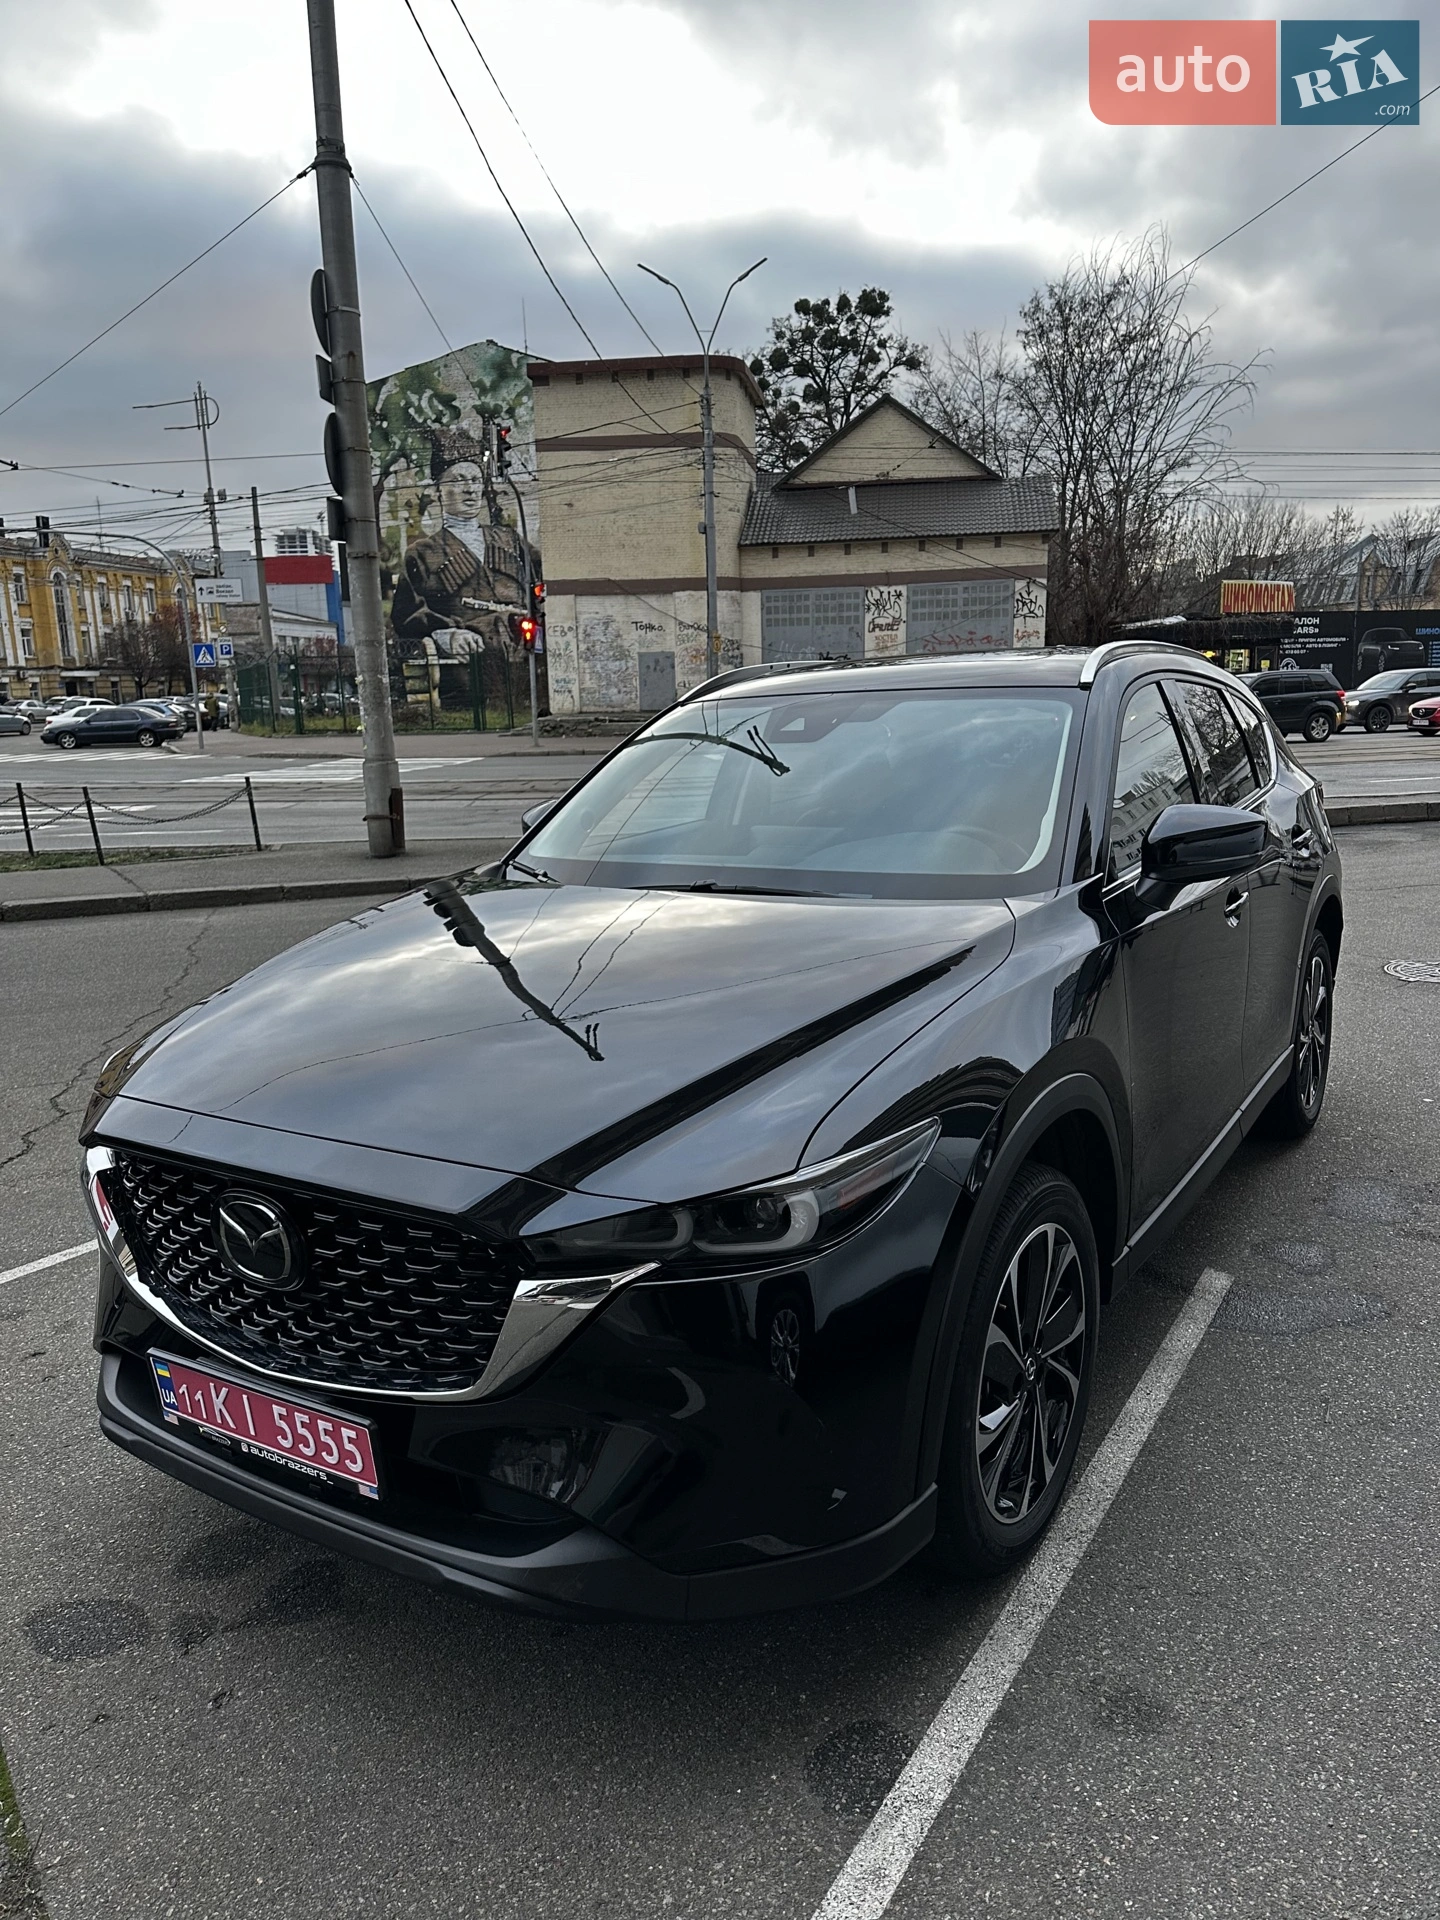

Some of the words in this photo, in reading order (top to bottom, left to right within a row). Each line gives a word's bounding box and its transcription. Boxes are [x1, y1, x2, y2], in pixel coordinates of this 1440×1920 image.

[1223, 583, 1295, 613] ШИНОМОНТАЖ
[161, 1388, 178, 1406] UA
[272, 1403, 364, 1473] 5555
